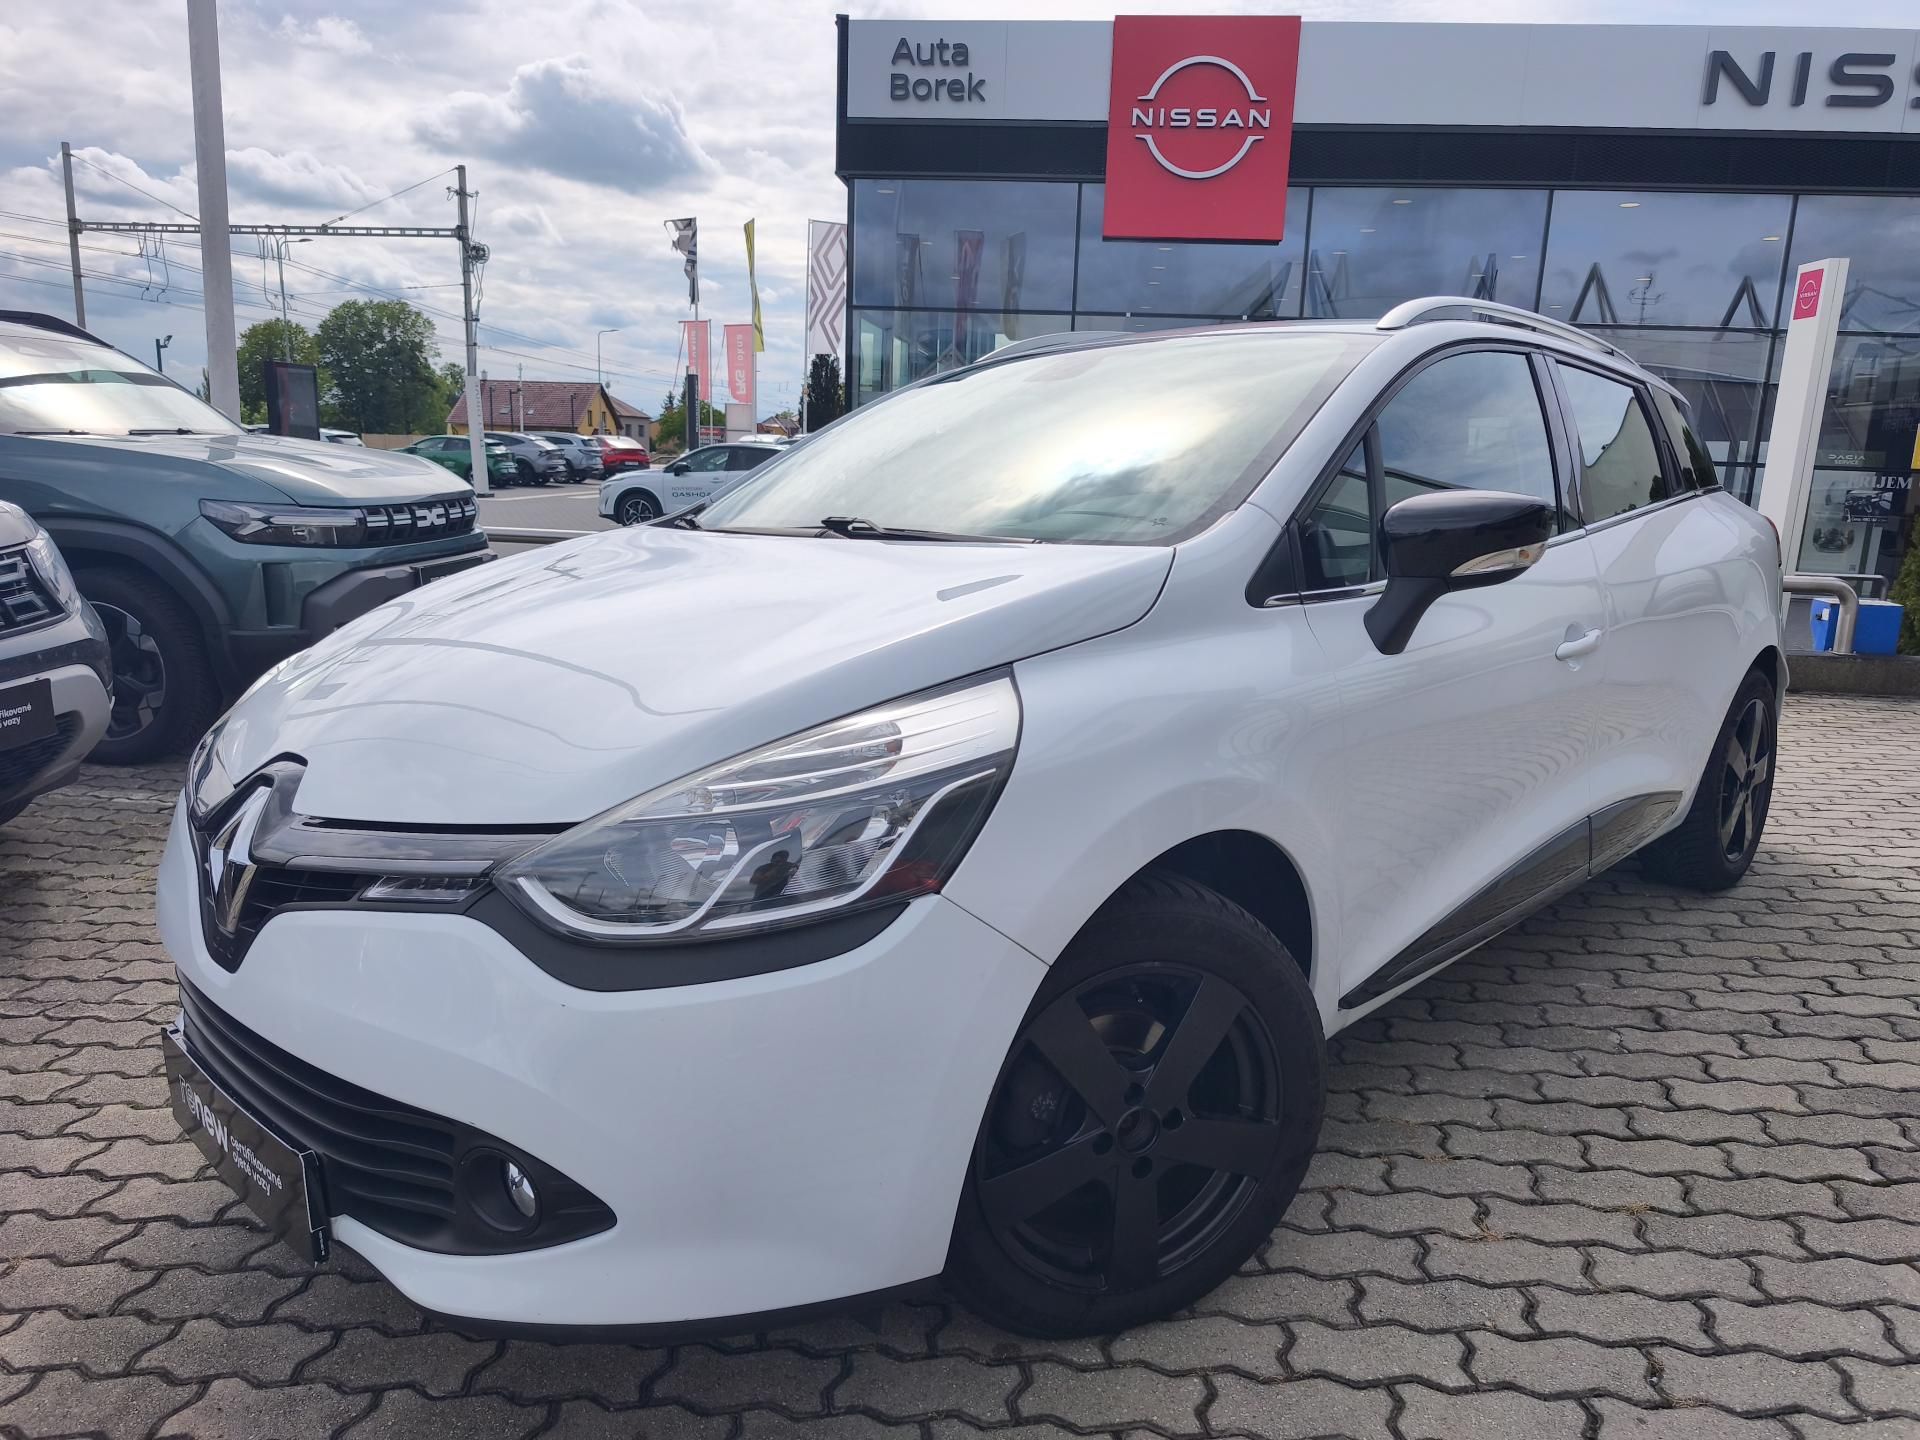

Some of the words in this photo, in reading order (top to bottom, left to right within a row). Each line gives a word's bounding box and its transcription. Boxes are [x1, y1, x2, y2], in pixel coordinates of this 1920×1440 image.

[891, 38, 970, 66] Auta
[890, 72, 987, 102] Borek
[1130, 107, 1272, 129] NISSAN
[1827, 453, 1866, 461] DACIA
[2, 716, 21, 727] vozy
[178, 1073, 229, 1153] renew
[230, 1135, 283, 1190] certifikované
[232, 1151, 252, 1176] ojeté
[251, 1168, 271, 1196] vozy
